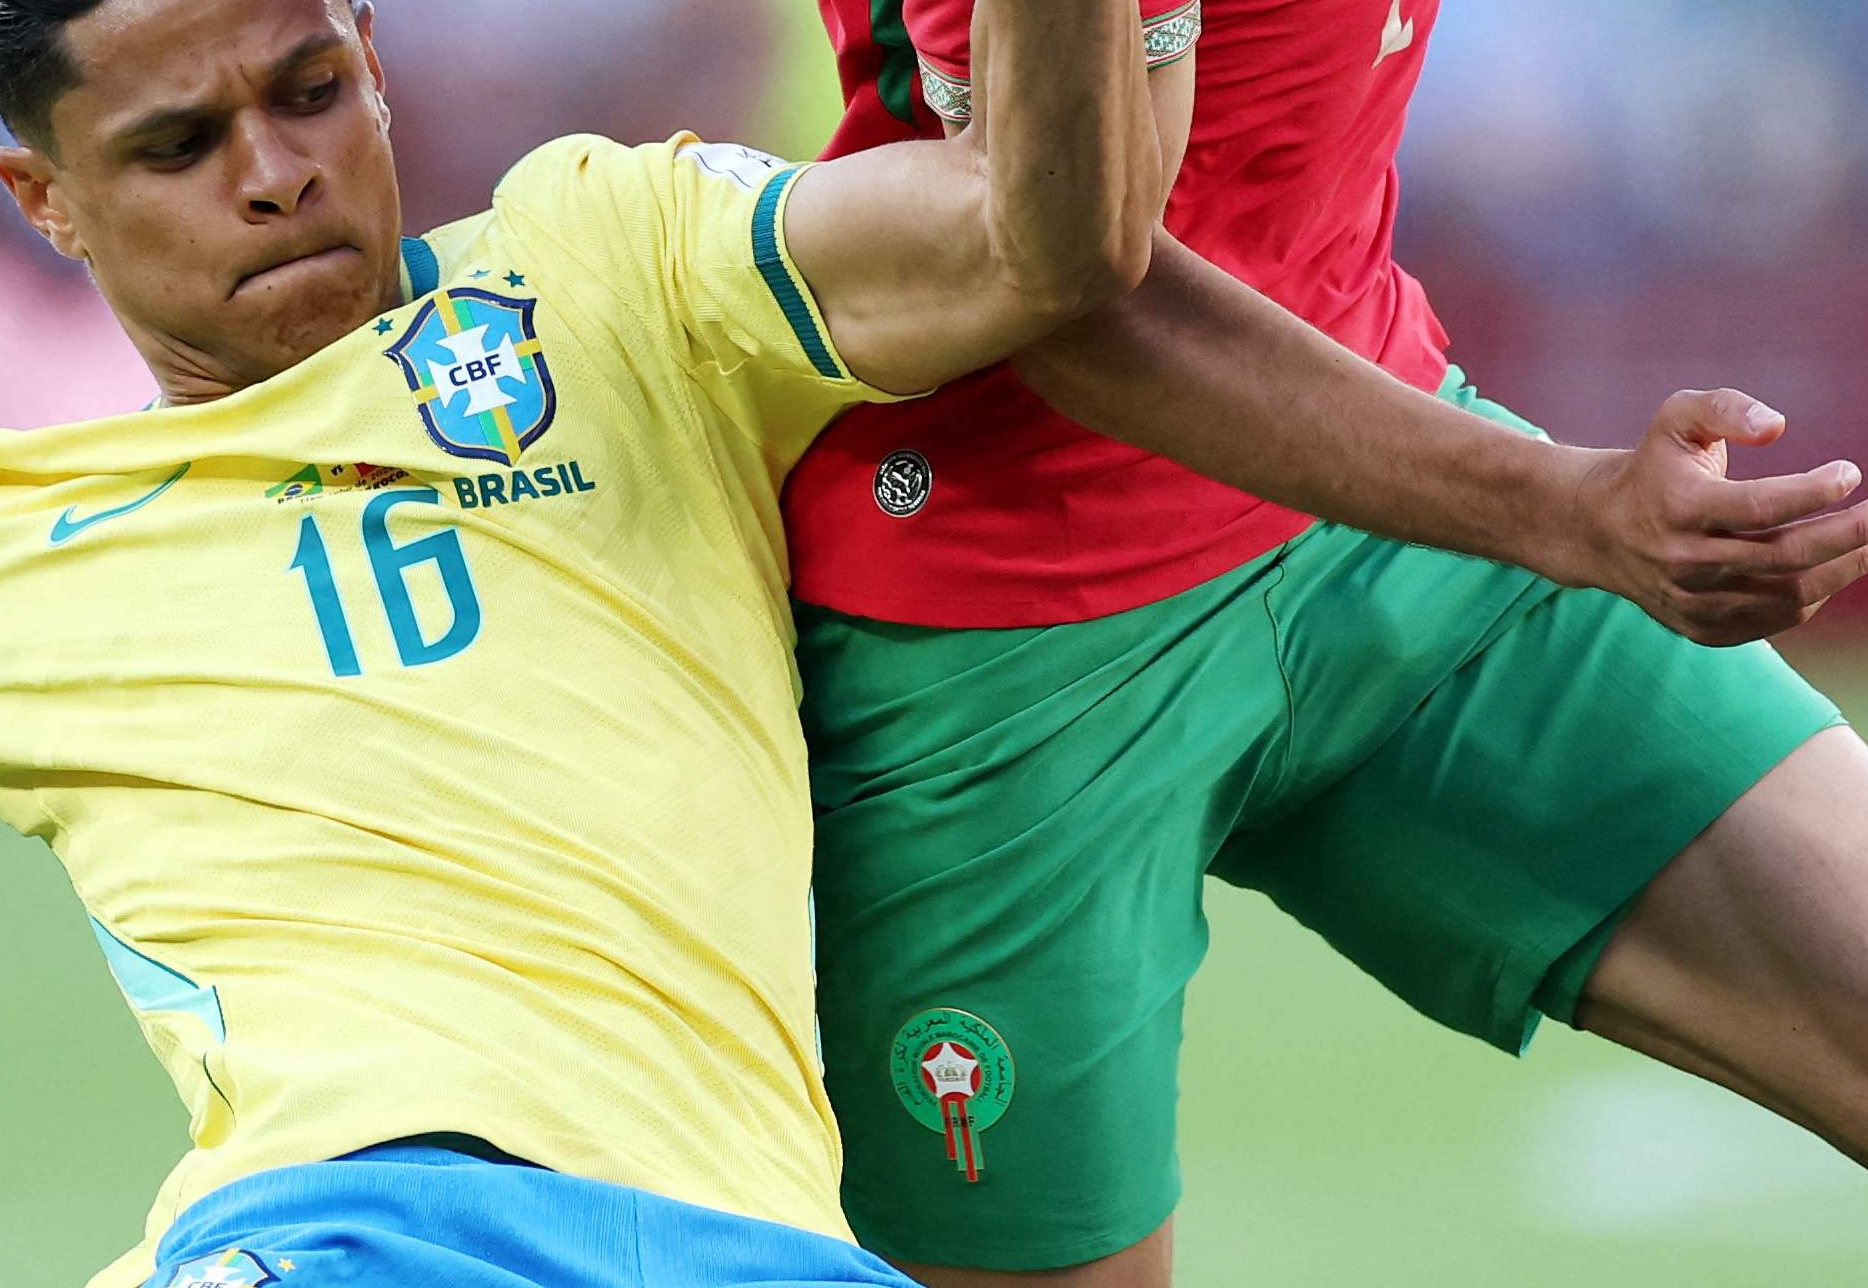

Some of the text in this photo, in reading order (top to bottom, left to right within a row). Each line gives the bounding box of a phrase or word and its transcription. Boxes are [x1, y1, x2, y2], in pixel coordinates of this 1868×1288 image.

[448, 353, 502, 387] CBF
[453, 460, 596, 509] BRASIL
[286, 488, 483, 678] 16
